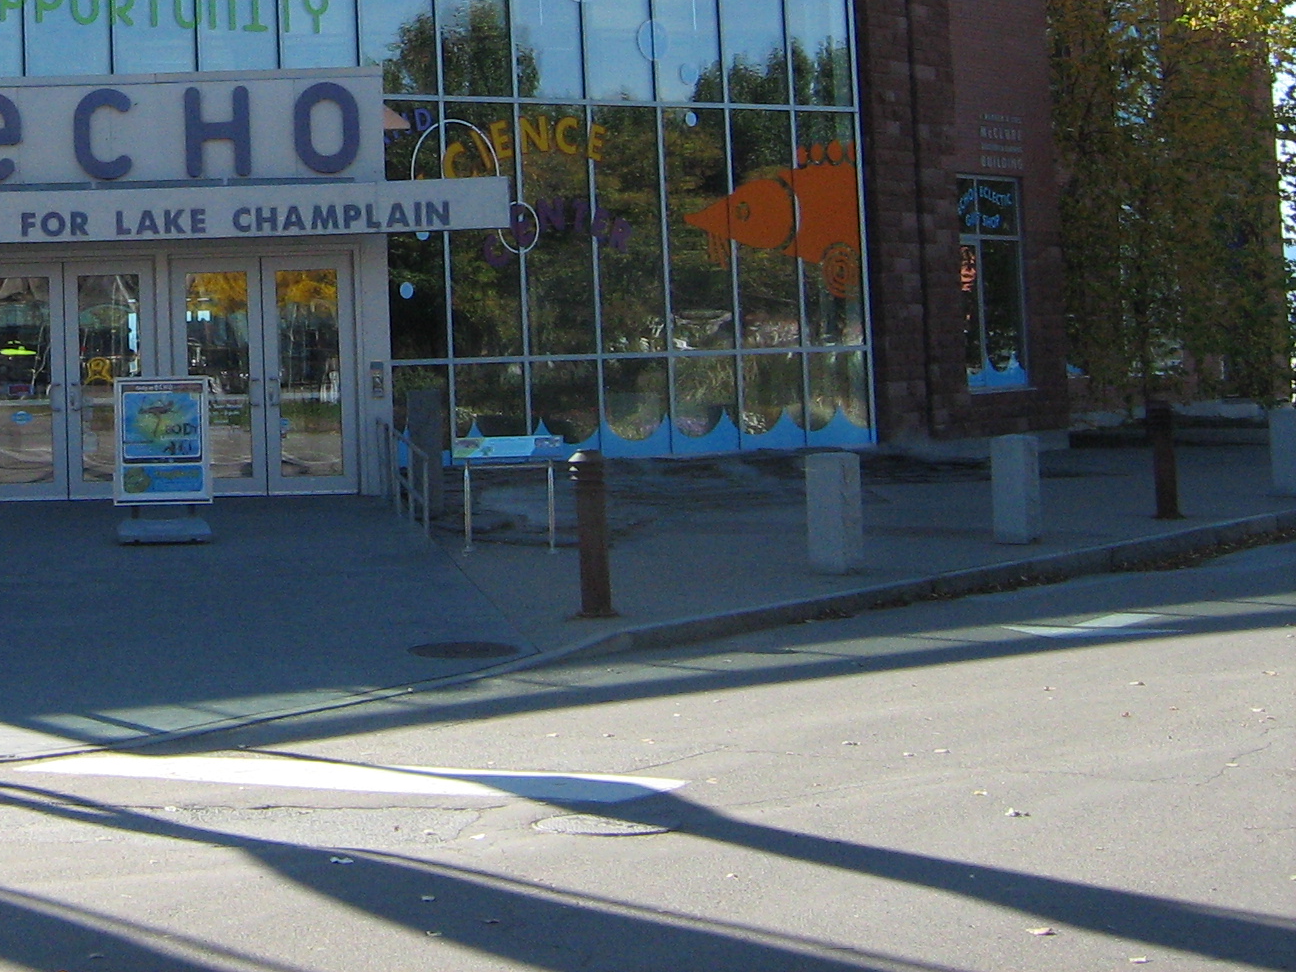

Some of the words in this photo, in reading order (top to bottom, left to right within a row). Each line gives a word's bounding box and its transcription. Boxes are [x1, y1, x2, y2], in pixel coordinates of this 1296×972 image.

[415, 113, 608, 181] CIENCE
[21, 211, 90, 237] FOR
[115, 208, 206, 235] LAKE
[232, 201, 452, 233] CHAMPLAIN
